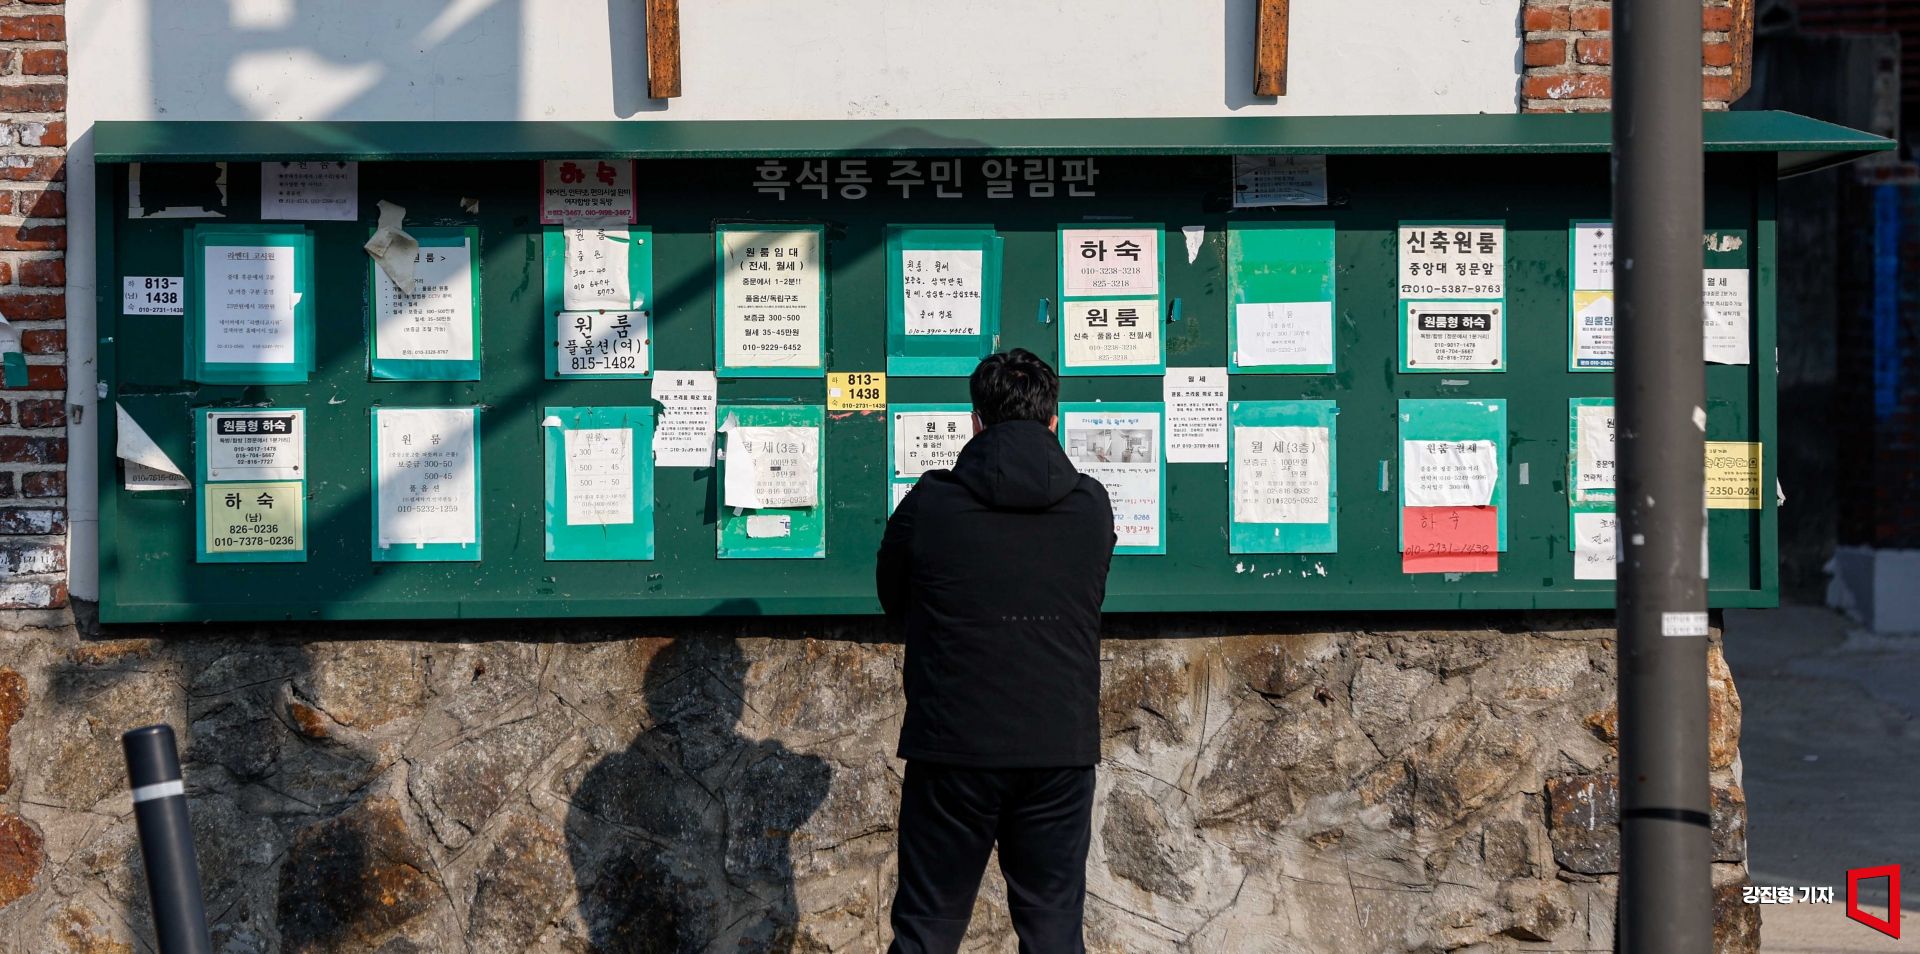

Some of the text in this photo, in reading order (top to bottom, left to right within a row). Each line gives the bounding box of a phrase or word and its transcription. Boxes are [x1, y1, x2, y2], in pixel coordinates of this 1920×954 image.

[753, 157, 1099, 201] 흑석동 주민 알림판
[1407, 231, 1496, 254] 신축원룸
[254, 252, 274, 260] 고시원
[1409, 263, 1494, 276] 중앙대 정문앞
[145, 278, 177, 288] 813-
[146, 293, 177, 303] 1438
[1424, 317, 1485, 328] 원룸형 하숙
[572, 357, 635, 369] 815-1482
[848, 375, 879, 385] 813-
[849, 389, 879, 399] 1438
[224, 420, 286, 432] 원룸형 하숙
[246, 513, 261, 522] (남)
[230, 525, 278, 534] 826-0236
[215, 536, 294, 546] 010-7378-0236
